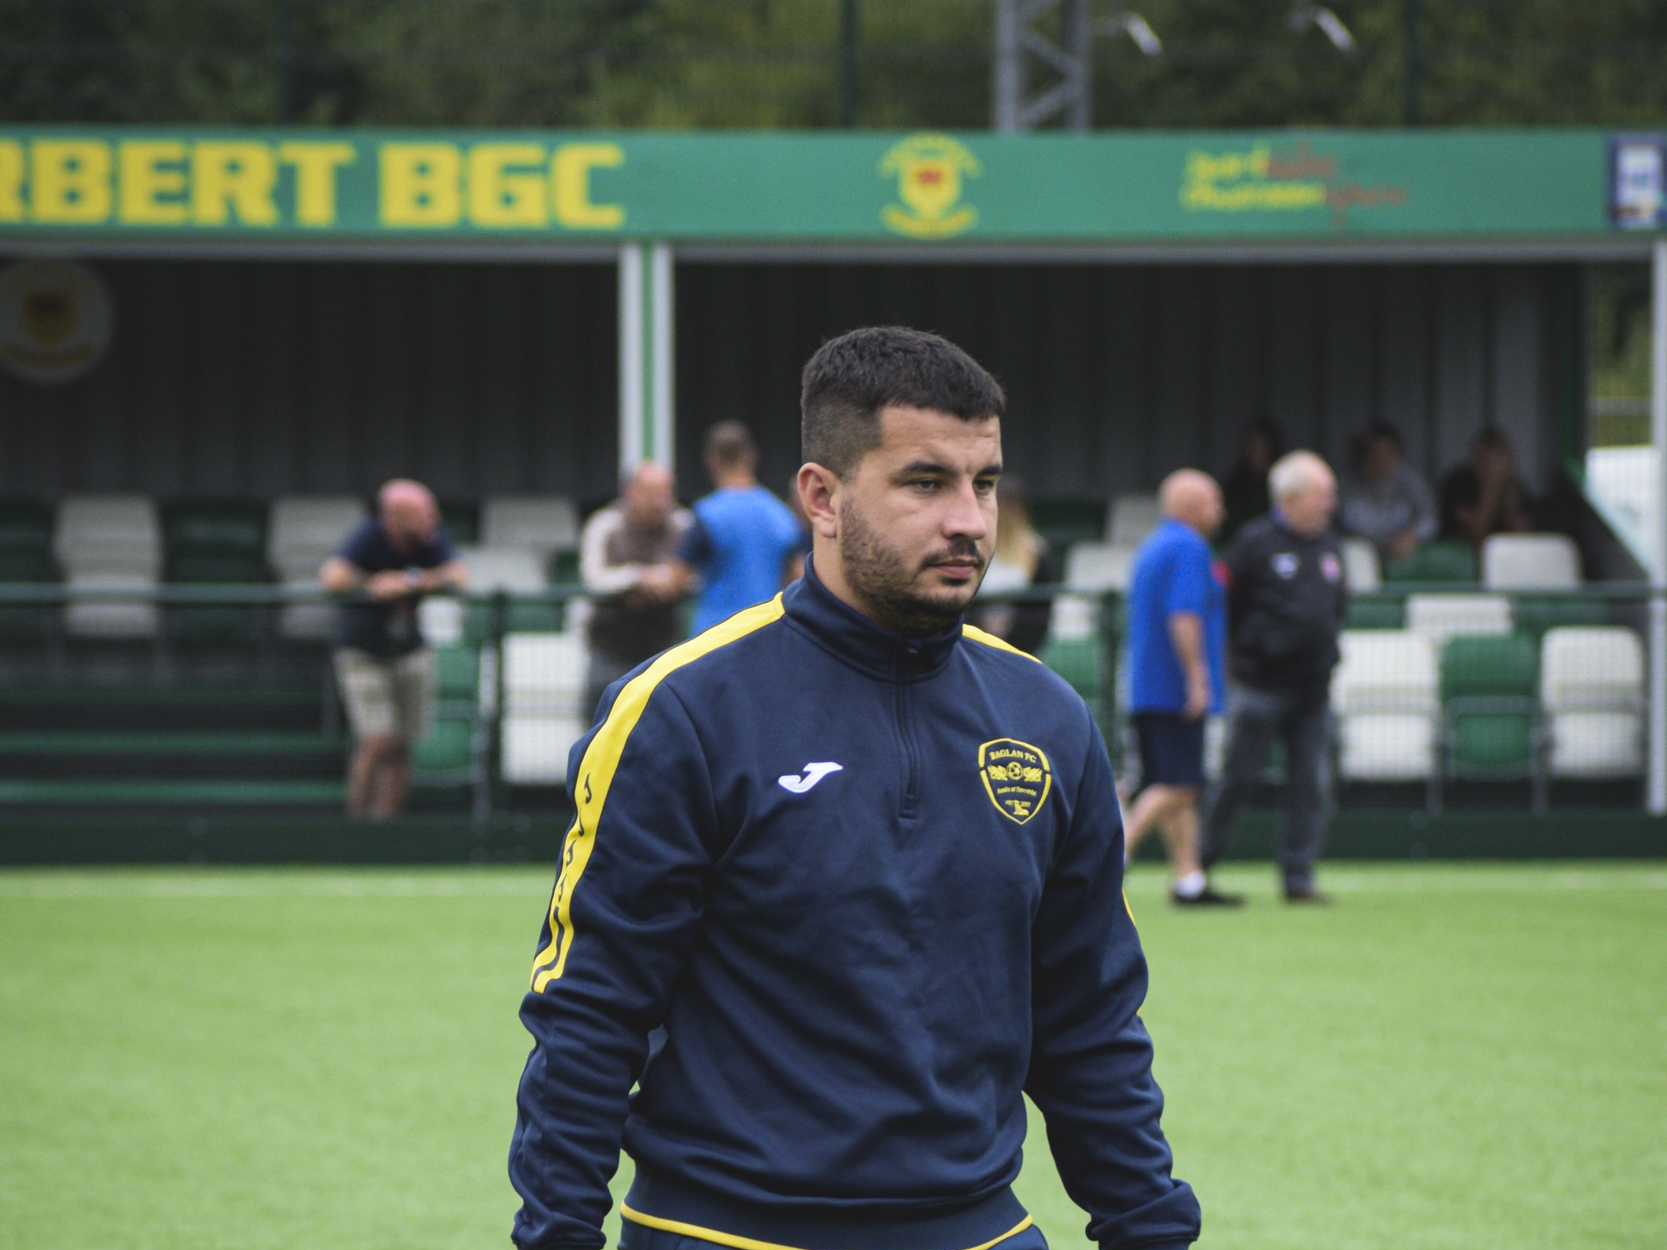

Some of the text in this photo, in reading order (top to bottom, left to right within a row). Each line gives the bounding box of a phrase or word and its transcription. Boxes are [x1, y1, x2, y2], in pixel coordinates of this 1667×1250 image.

[0, 139, 625, 229] BERT BGC
[1024, 752, 1037, 763] FC
